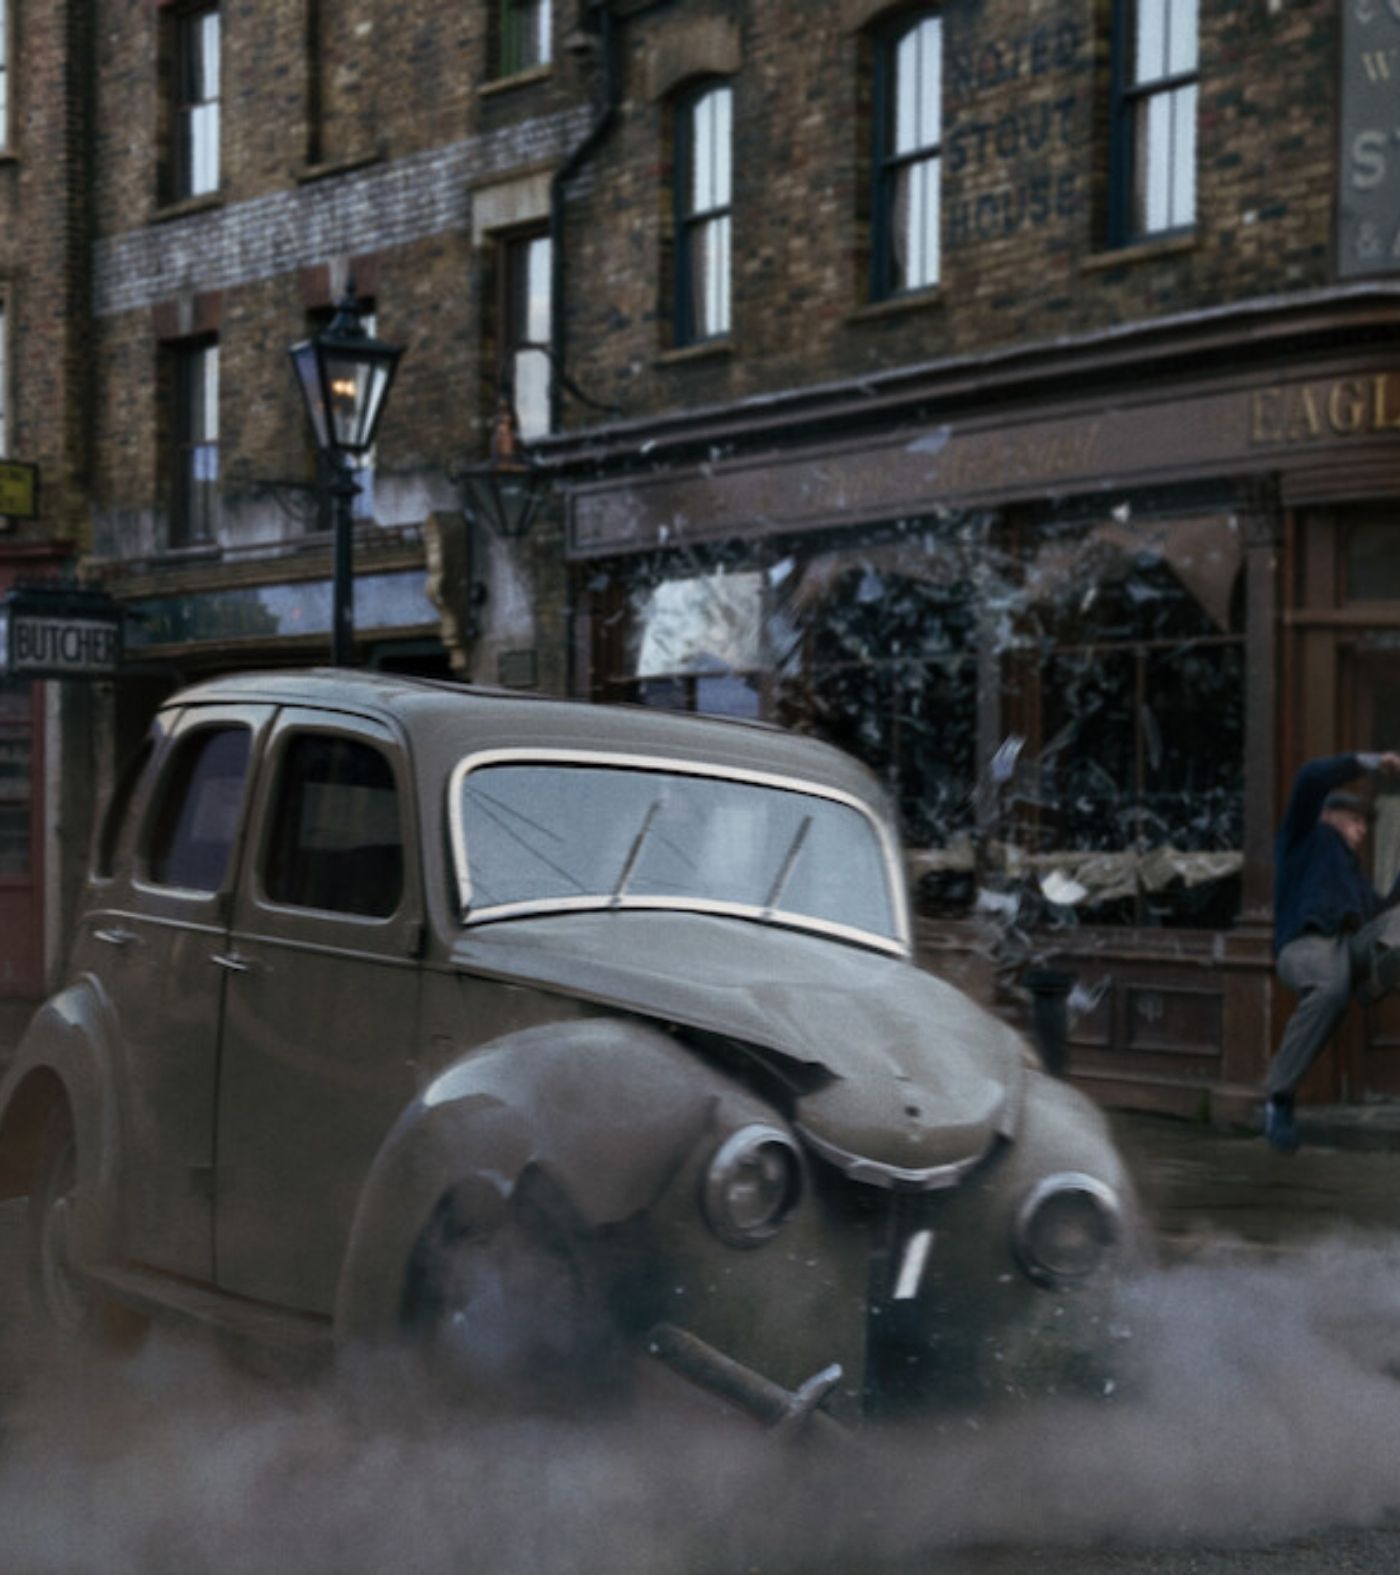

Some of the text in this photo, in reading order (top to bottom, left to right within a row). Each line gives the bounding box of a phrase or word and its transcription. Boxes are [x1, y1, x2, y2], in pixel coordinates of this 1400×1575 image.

[949, 95, 1077, 173] STOUT
[949, 174, 1079, 244] HOUSE
[18, 623, 118, 663] BUTCHER
